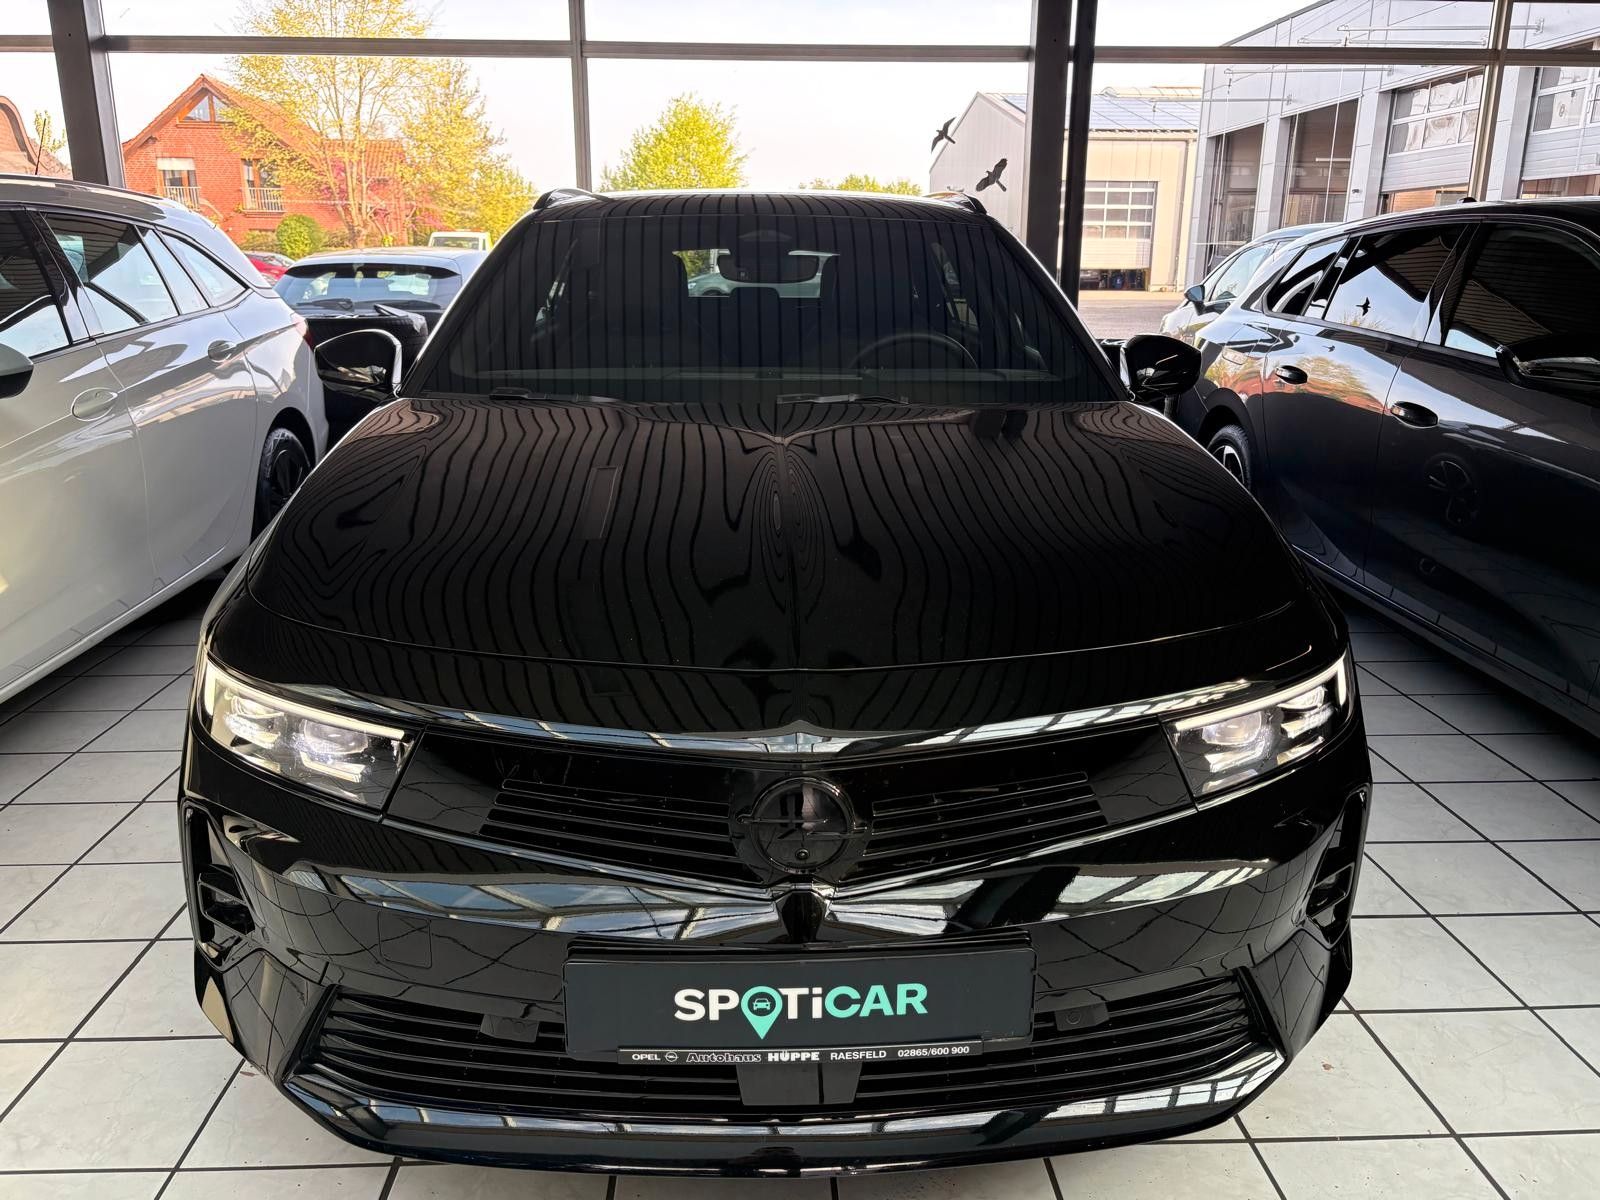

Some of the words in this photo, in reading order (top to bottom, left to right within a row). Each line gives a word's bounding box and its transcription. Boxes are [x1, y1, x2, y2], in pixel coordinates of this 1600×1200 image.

[631, 1053, 661, 1061] OPEL
[686, 1052, 762, 1063] Autohaus
[767, 1050, 820, 1062] HÜPPE
[830, 1050, 887, 1061] RAESFELD
[897, 1047, 949, 1058] 02865/600
[951, 1046, 970, 1055] 900
